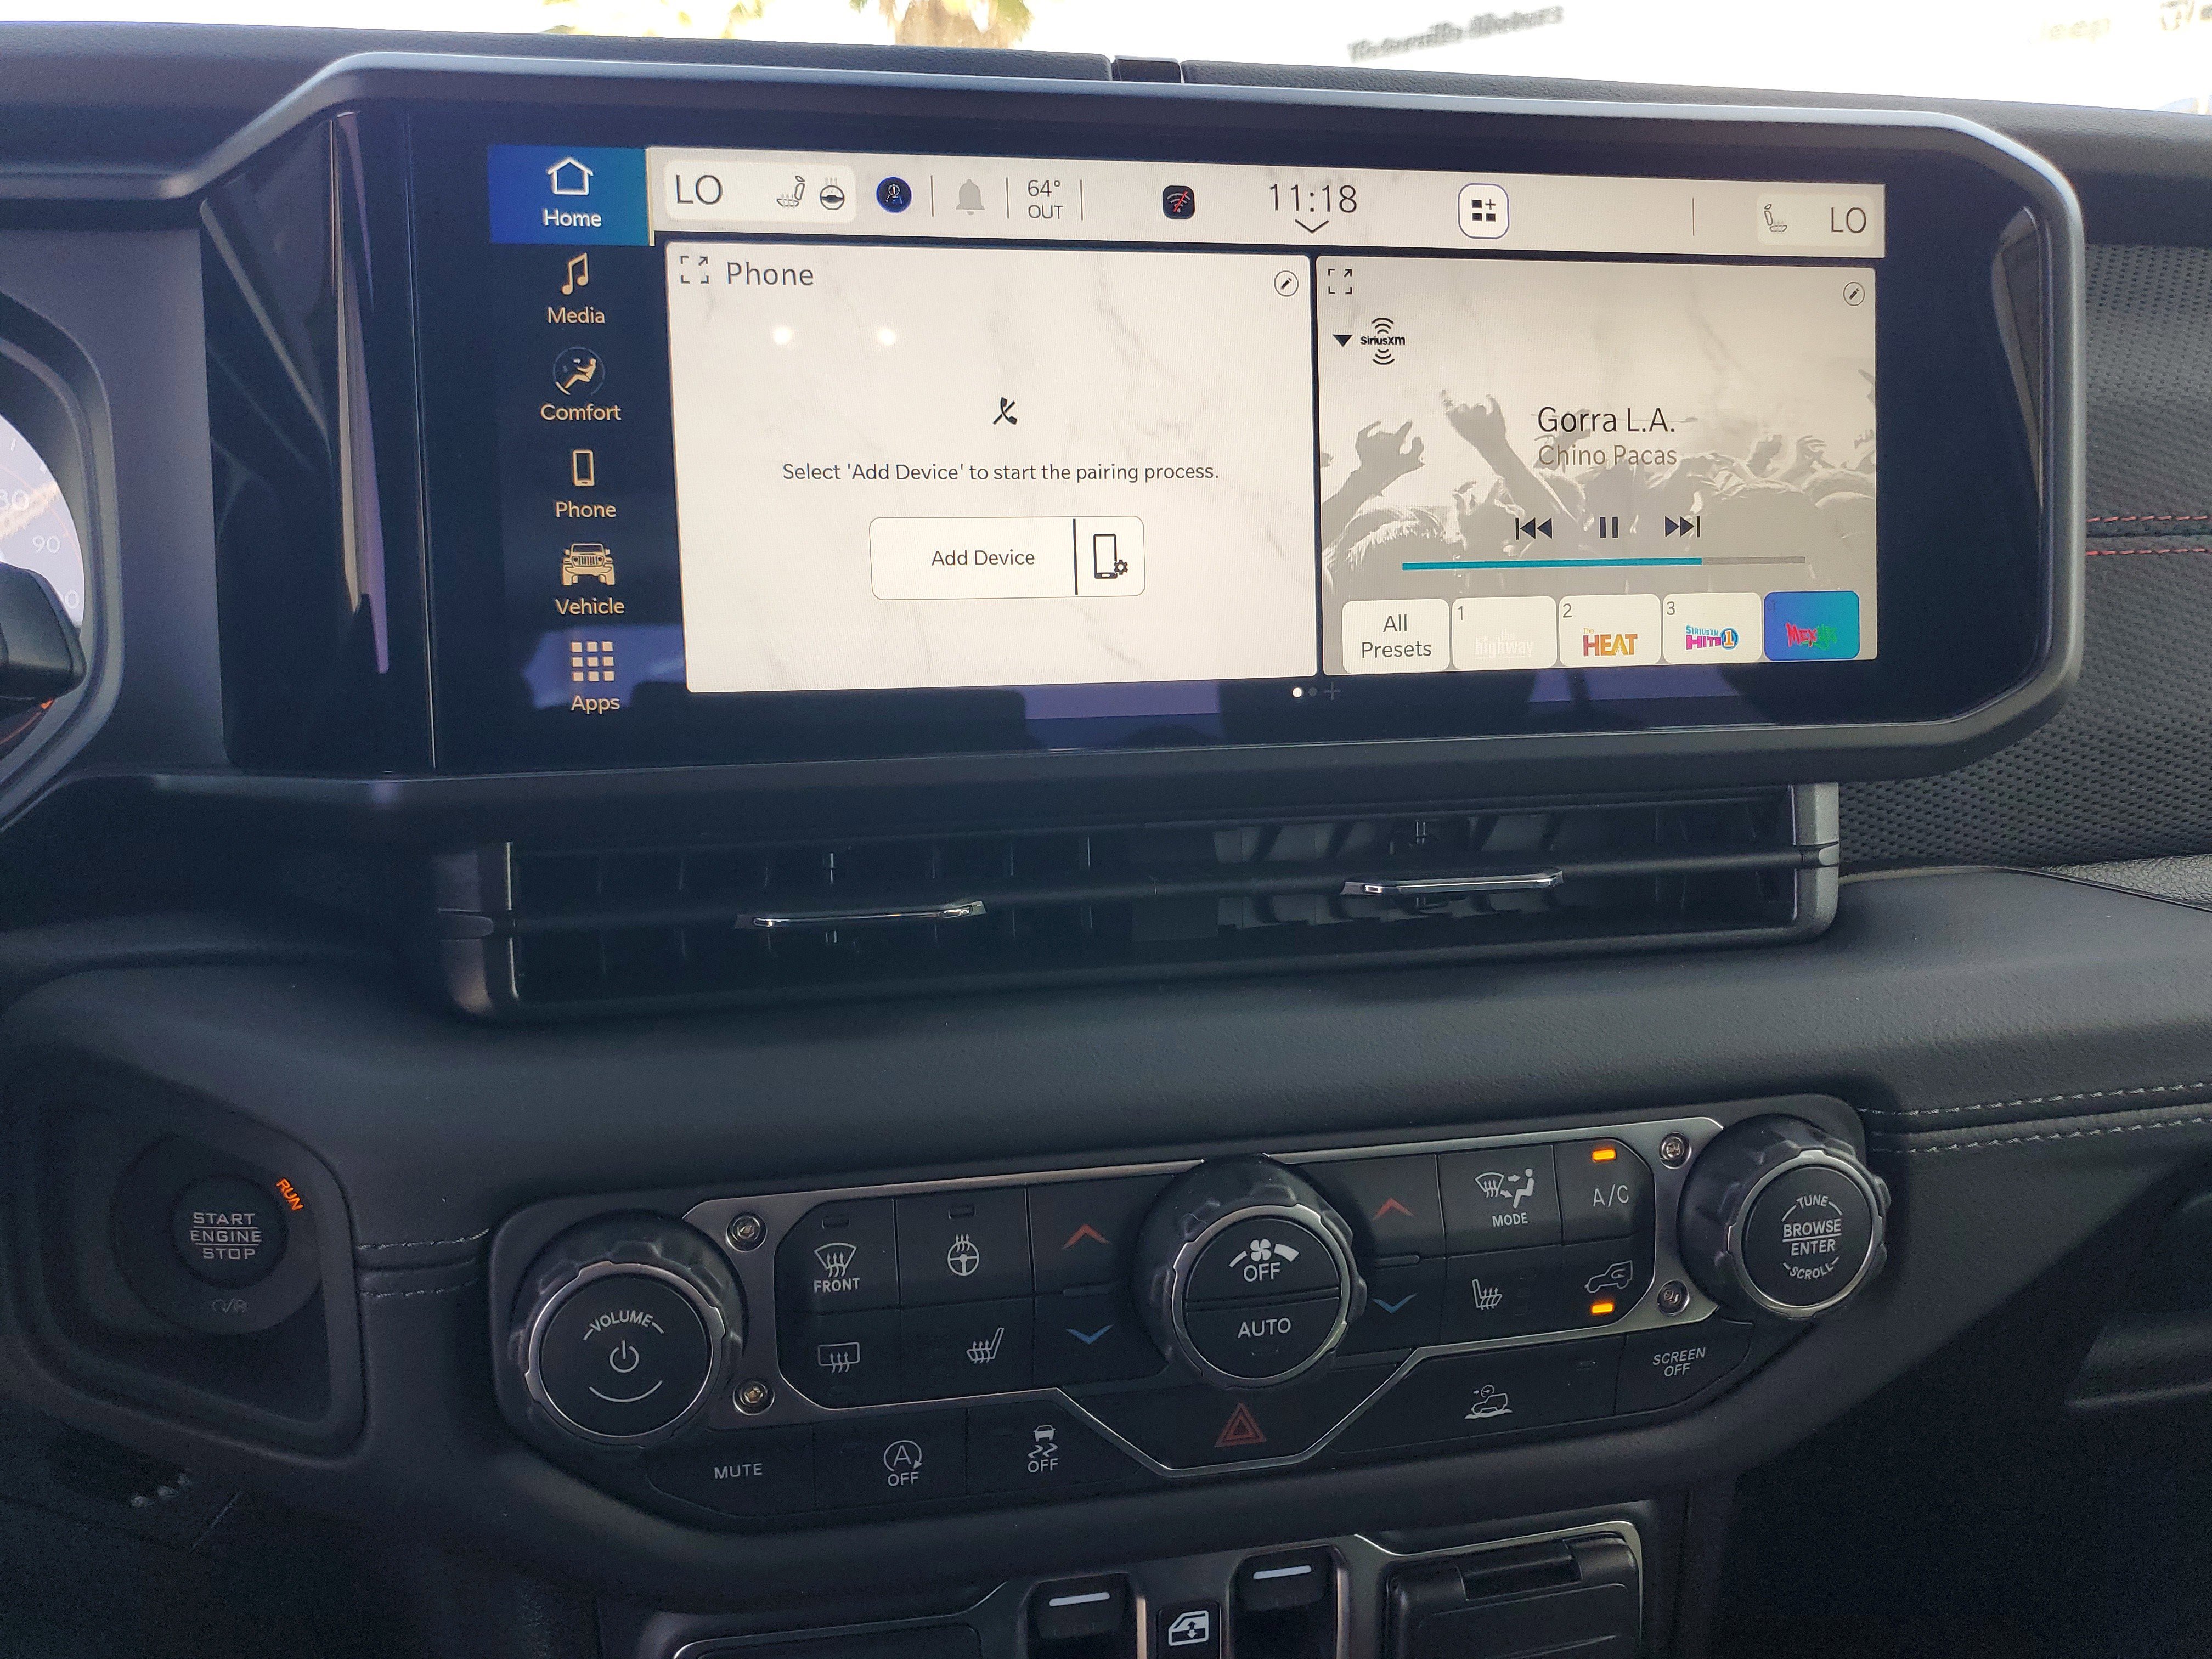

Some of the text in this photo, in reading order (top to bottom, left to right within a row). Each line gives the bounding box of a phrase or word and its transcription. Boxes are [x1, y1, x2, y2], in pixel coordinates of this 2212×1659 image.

[676, 174, 723, 205] LO
[1028, 179, 1060, 198] 64°
[1269, 183, 1357, 213] 11:18
[544, 208, 602, 227] Home
[1028, 205, 1064, 219] OUT
[1831, 207, 1866, 234] LO
[727, 262, 814, 286] Phone
[548, 306, 605, 324] Media
[540, 403, 622, 420] Comfort
[1538, 407, 1674, 433] Gorra L.A.
[1538, 444, 1677, 467] Chino Pacas
[783, 462, 1218, 483] Select 'Add Device' to start the pairing process.
[556, 500, 616, 518] Phone
[32, 534, 61, 554] 90
[932, 549, 1035, 566] Add Device
[555, 597, 624, 615] Vehicle
[1458, 606, 1463, 620] 1
[1562, 603, 1572, 618] 2
[1666, 601, 1675, 616] 3
[1383, 614, 1407, 633] All
[1362, 641, 1431, 659] Presets
[1583, 633, 1638, 657] HEAT
[571, 695, 620, 714] Apps
[276, 1177, 303, 1210] RUN
[1593, 1184, 1629, 1207] A/C
[1797, 1194, 1829, 1208] TUNE
[193, 1212, 256, 1225] START
[1492, 1212, 1528, 1227] MODE
[1783, 1218, 1842, 1237] BROWSE
[190, 1229, 262, 1243] ENGINE
[203, 1248, 255, 1260] STOP
[1791, 1239, 1836, 1256] ENTER
[1244, 1262, 1281, 1282] OFF
[1790, 1263, 1833, 1280] SCROLL
[814, 1278, 860, 1293] FRONT
[590, 1310, 653, 1333] VOLUME
[1238, 1317, 1291, 1338] AUTO
[1652, 1347, 1706, 1365] SCREEN
[1663, 1362, 1691, 1377] OFF
[714, 1463, 763, 1479] MUTE
[1028, 1458, 1059, 1474] OFF
[887, 1471, 919, 1486] OFF
